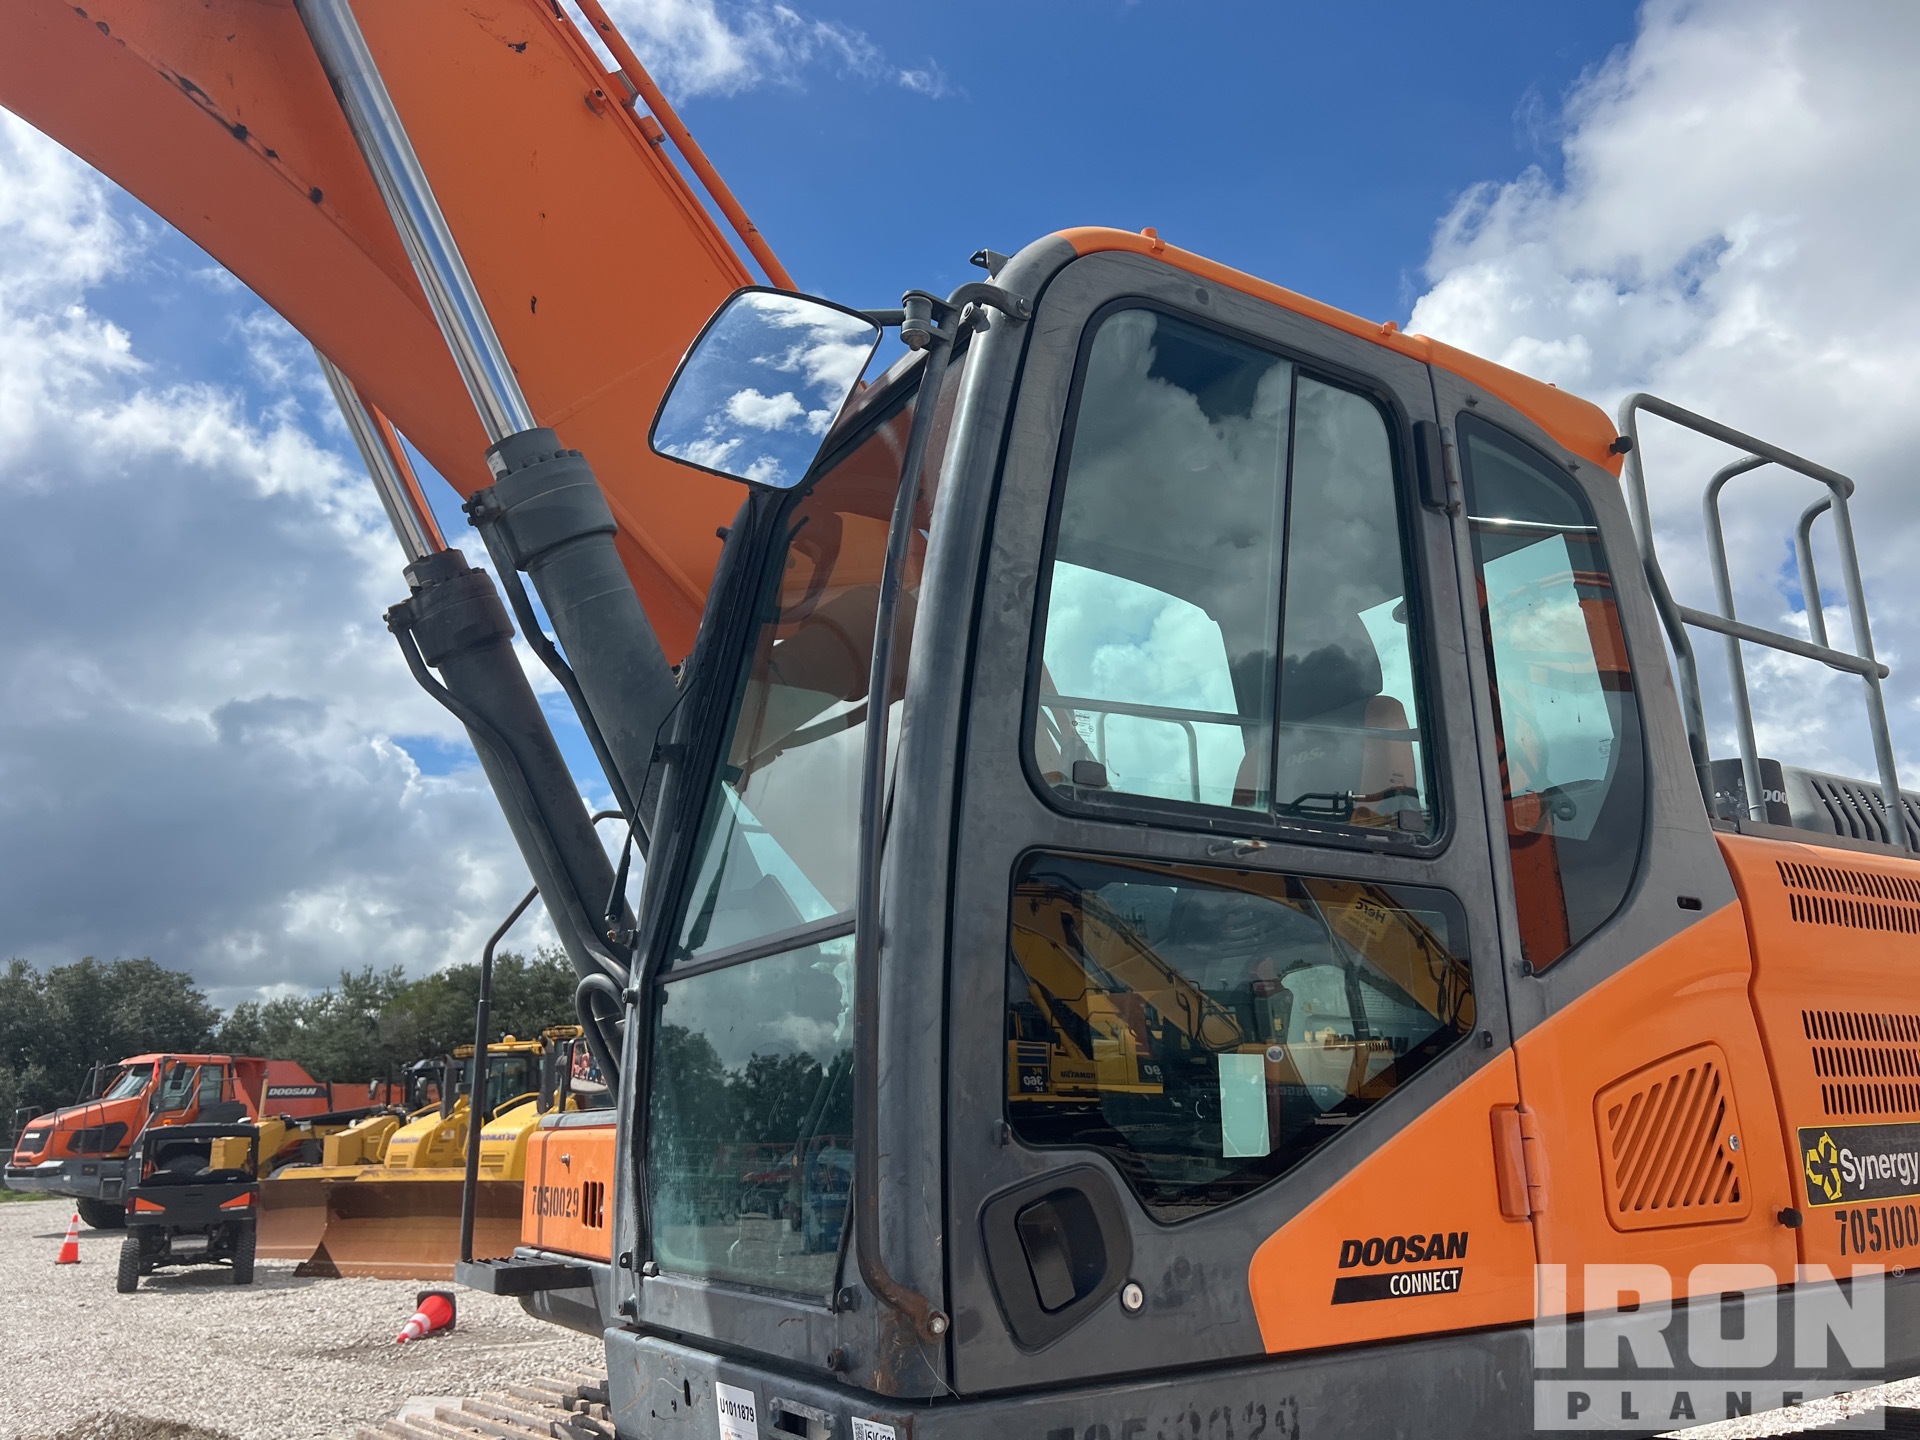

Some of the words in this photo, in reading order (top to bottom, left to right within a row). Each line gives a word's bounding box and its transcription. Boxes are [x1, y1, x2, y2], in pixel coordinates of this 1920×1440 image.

[268, 1087, 317, 1096] DOOSAN
[1840, 1148, 1919, 1190] Synergy
[532, 1185, 580, 1218] 70510029
[1835, 1204, 1920, 1256] 705100
[1338, 1231, 1469, 1268] DOOSAN
[1389, 1269, 1459, 1296] CONNECT
[719, 1397, 755, 1423] U1011879
